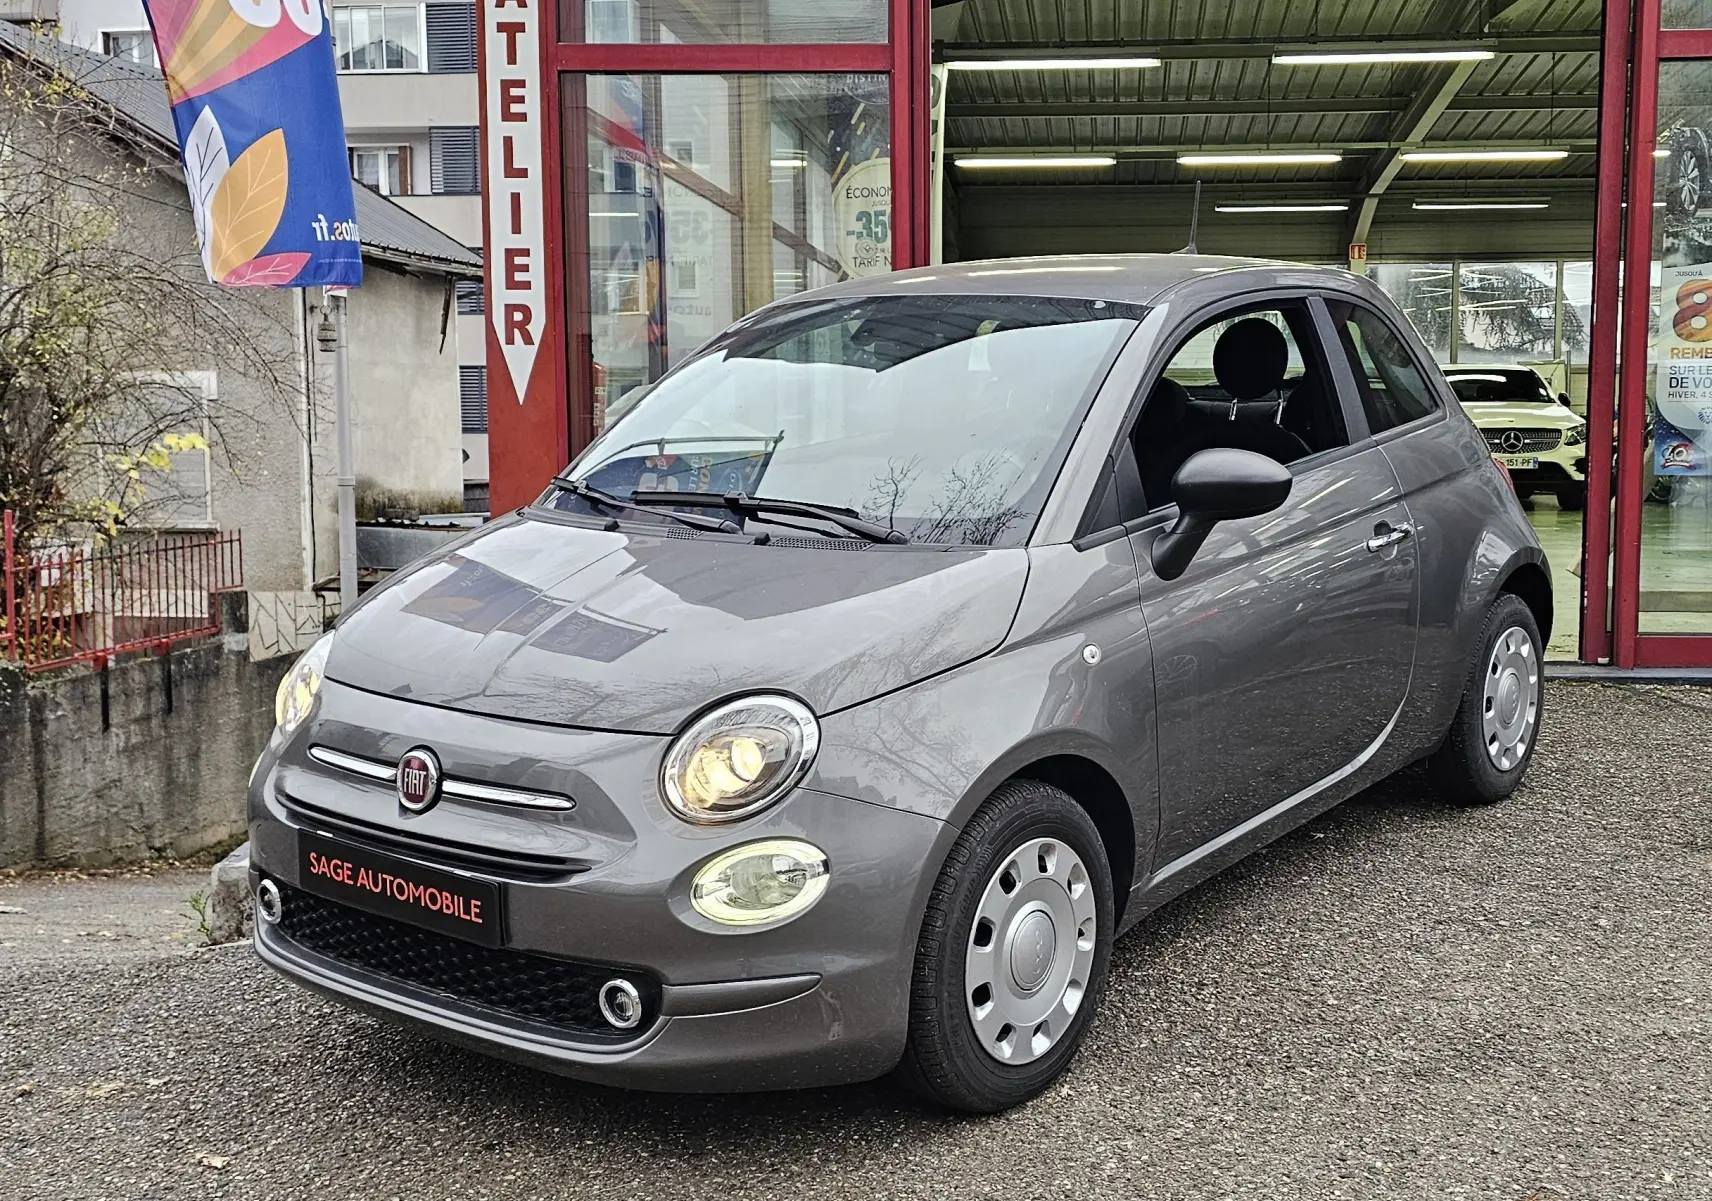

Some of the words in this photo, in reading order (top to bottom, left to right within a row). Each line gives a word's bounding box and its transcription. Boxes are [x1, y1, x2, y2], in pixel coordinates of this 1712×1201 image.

[494, 0, 536, 346] TELIER
[845, 185, 892, 199] ÉCONO
[846, 209, 891, 244] -35
[852, 256, 880, 268] TARIF
[1670, 347, 1712, 360] REMB
[1669, 365, 1696, 376] SUR
[1668, 376, 1689, 389] DE
[1692, 376, 1712, 389] VO
[1668, 390, 1699, 400] HIVER,
[403, 767, 428, 797] FIAT
[309, 851, 354, 885] SAGE
[356, 867, 483, 924] AUTOMOBILE
